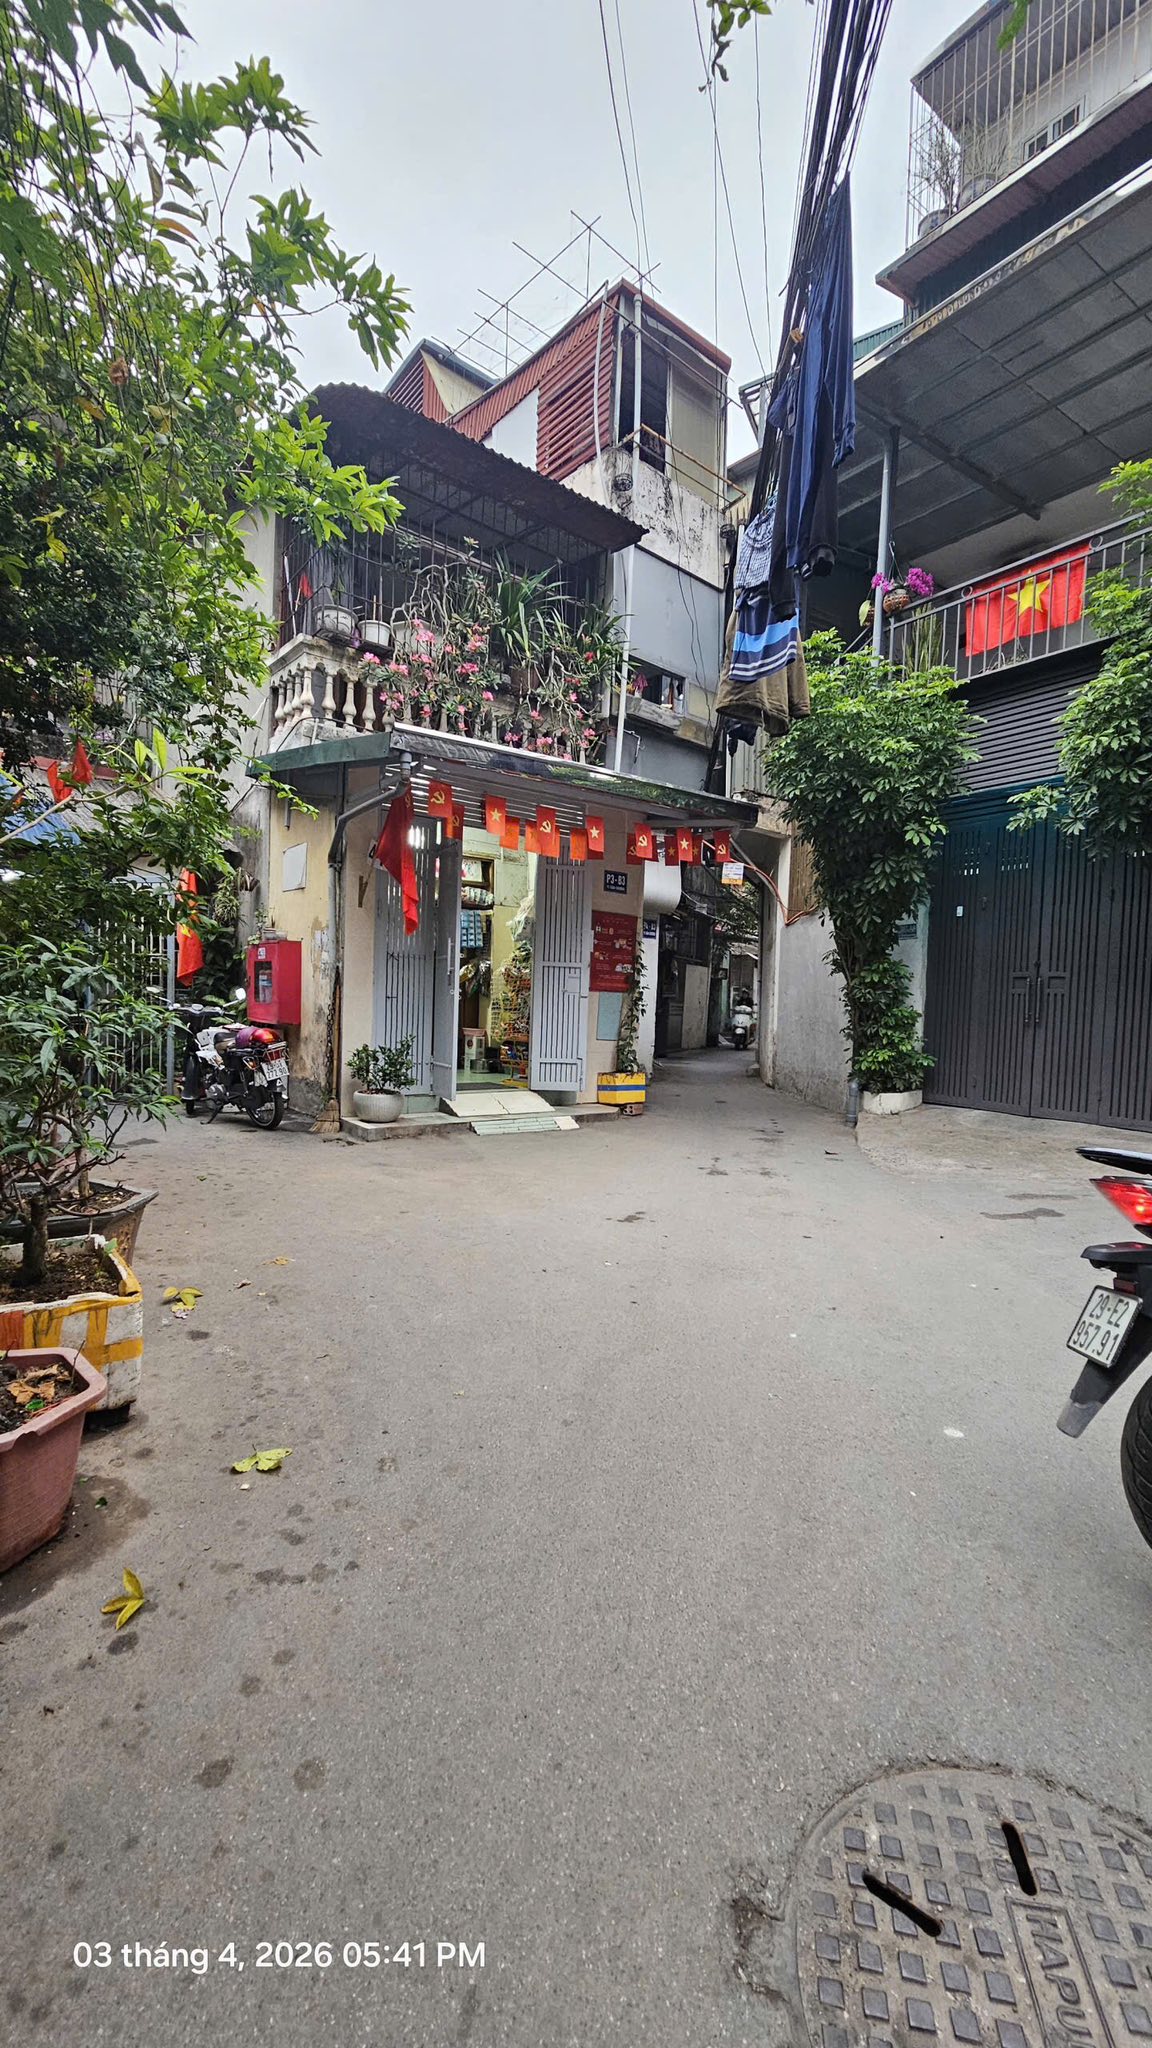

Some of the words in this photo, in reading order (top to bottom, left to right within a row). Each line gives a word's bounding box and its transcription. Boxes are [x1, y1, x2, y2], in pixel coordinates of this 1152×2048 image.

[1089, 1293, 1130, 1328] 29-E2
[1073, 1319, 1120, 1361] 957.91
[1026, 1913, 1096, 2048] HAPU
